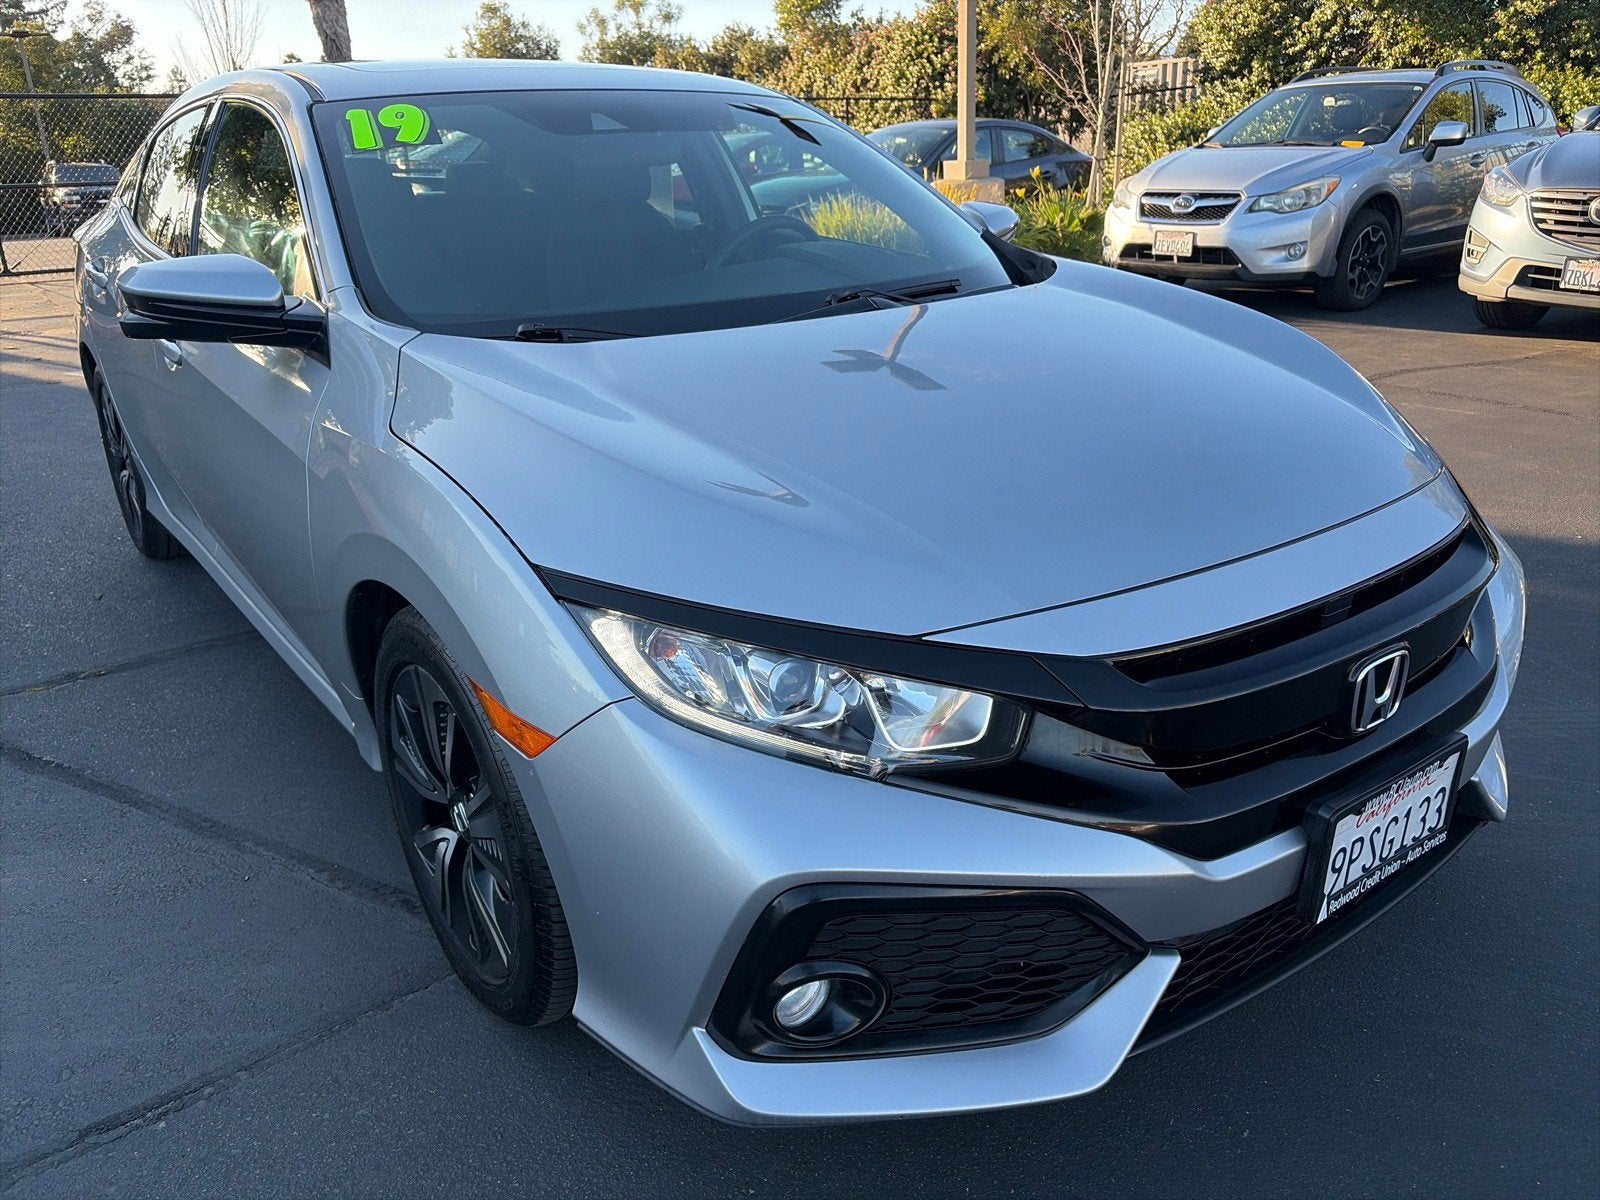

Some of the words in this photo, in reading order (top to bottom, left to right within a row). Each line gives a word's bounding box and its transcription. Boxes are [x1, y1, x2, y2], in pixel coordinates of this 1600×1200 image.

[345, 104, 430, 150] 19
[1567, 269, 1600, 288] 7RKL
[1356, 777, 1437, 829] California
[1326, 786, 1447, 898] 9PSG133
[1328, 883, 1361, 915] Redwood
[1360, 869, 1381, 893] Credit
[1381, 860, 1401, 884] Union
[1405, 846, 1423, 865] Auto
[1422, 830, 1448, 855] Services
